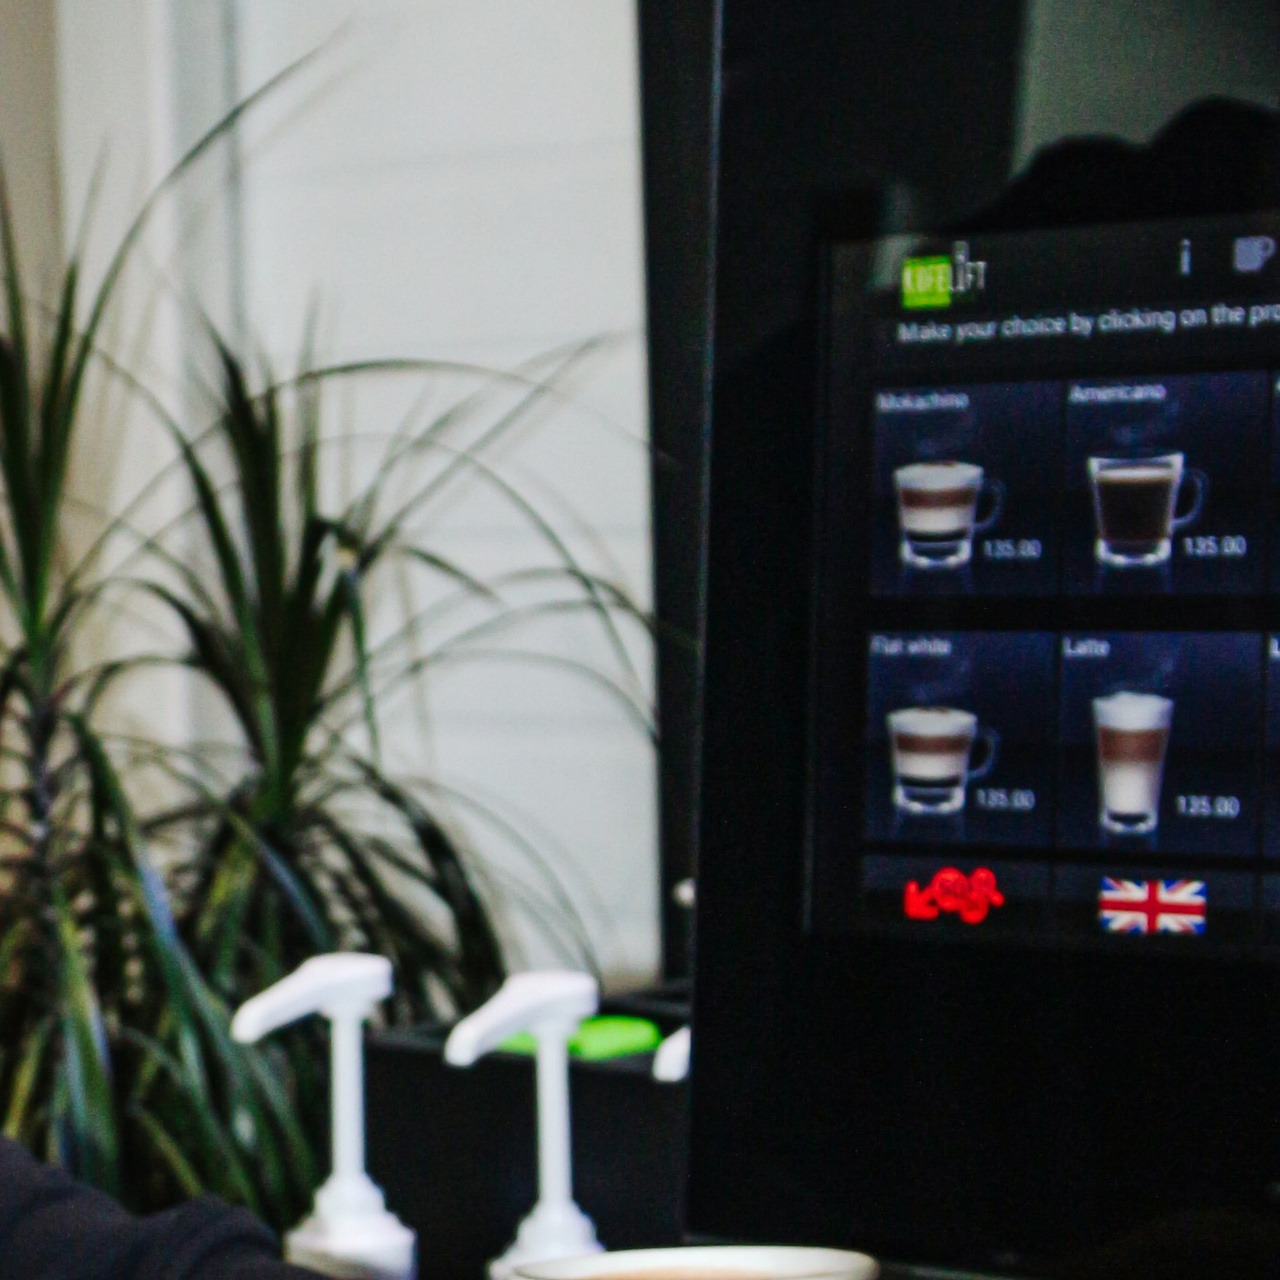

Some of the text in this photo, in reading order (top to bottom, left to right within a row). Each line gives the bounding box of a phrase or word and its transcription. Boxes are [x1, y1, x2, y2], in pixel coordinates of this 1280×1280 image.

[898, 321, 952, 342] Make
[955, 321, 996, 343] your
[1001, 316, 1067, 337] choice
[1070, 313, 1094, 337] by
[1097, 308, 1176, 334] clicking
[1179, 309, 1208, 327] on
[1211, 304, 1246, 325] the
[1063, 636, 1110, 657] Latte
